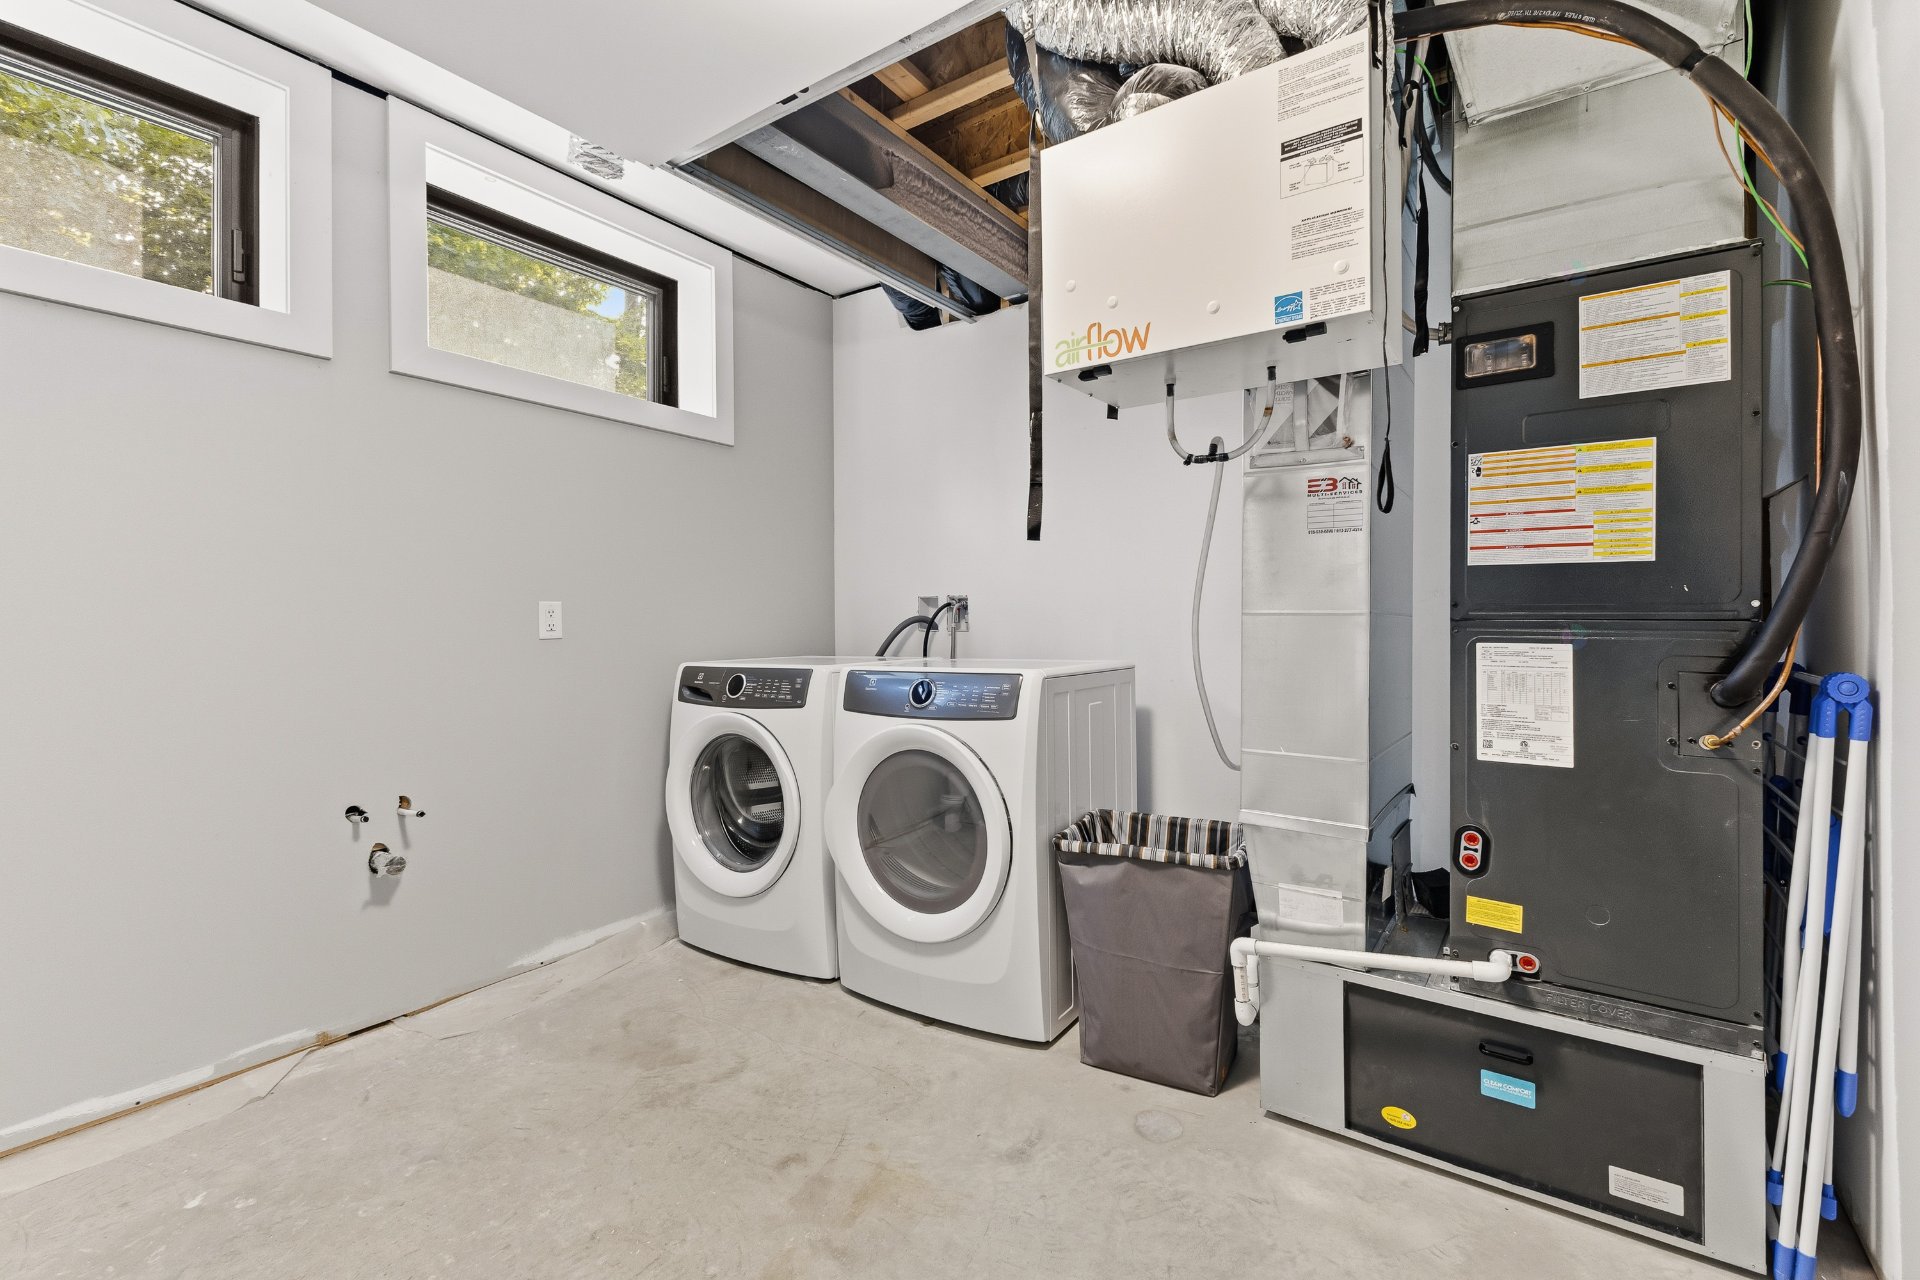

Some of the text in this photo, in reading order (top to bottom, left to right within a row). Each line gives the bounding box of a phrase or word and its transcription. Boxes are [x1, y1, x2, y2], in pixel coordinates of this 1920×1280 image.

[1055, 321, 1151, 367] airflow
[1546, 993, 1633, 1020] FILTER COVER
[1484, 1079, 1502, 1088] CLEAN
[1503, 1085, 1531, 1096] COMFORT
